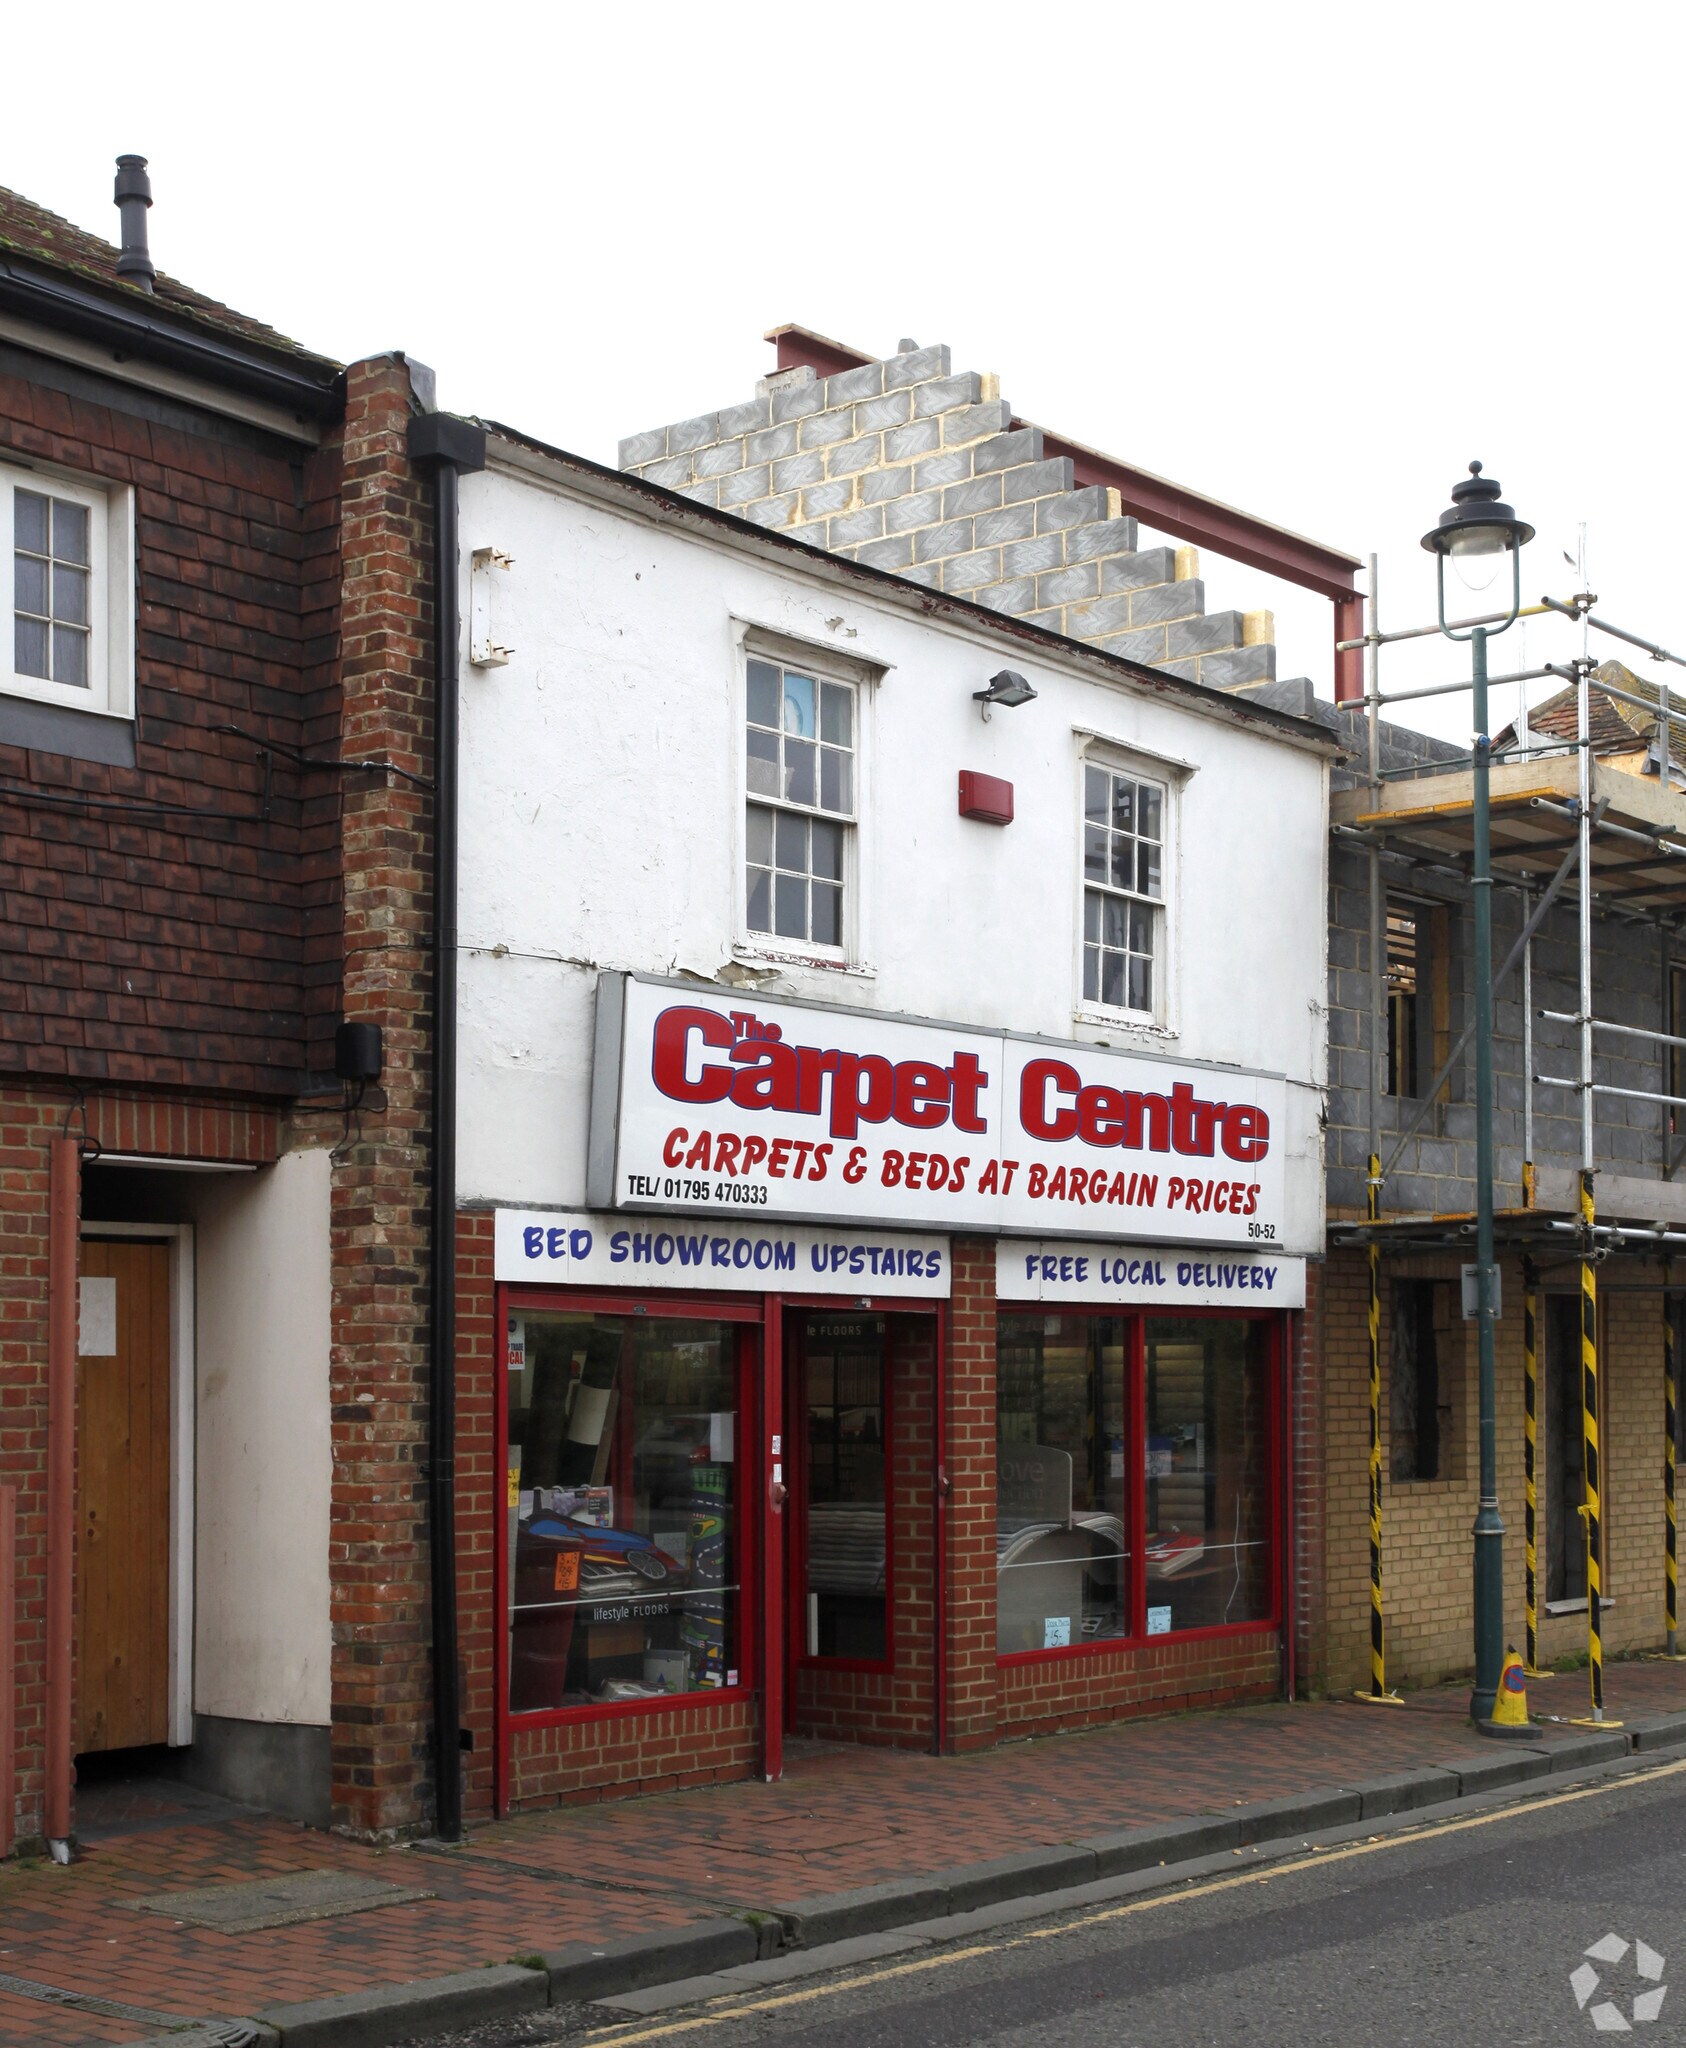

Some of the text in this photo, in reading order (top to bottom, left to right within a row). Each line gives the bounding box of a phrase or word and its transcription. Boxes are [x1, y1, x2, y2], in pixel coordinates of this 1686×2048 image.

[729, 1010, 783, 1042] The
[652, 1004, 1270, 1162] Carpet Centre
[663, 1127, 1260, 1215] CARPETS & BEDS AT BARGAIN PRICES
[627, 1174, 768, 1205] TEL/ 01795 470333
[1247, 1222, 1276, 1240] 50-52
[522, 1226, 941, 1278] BED SHOWROOM UPSTAIRS
[1025, 1254, 1278, 1290] FREE LOCAL DELIVERY
[820, 1325, 862, 1337] FLOORS
[593, 1603, 670, 1622] lifestyle FLOORS
